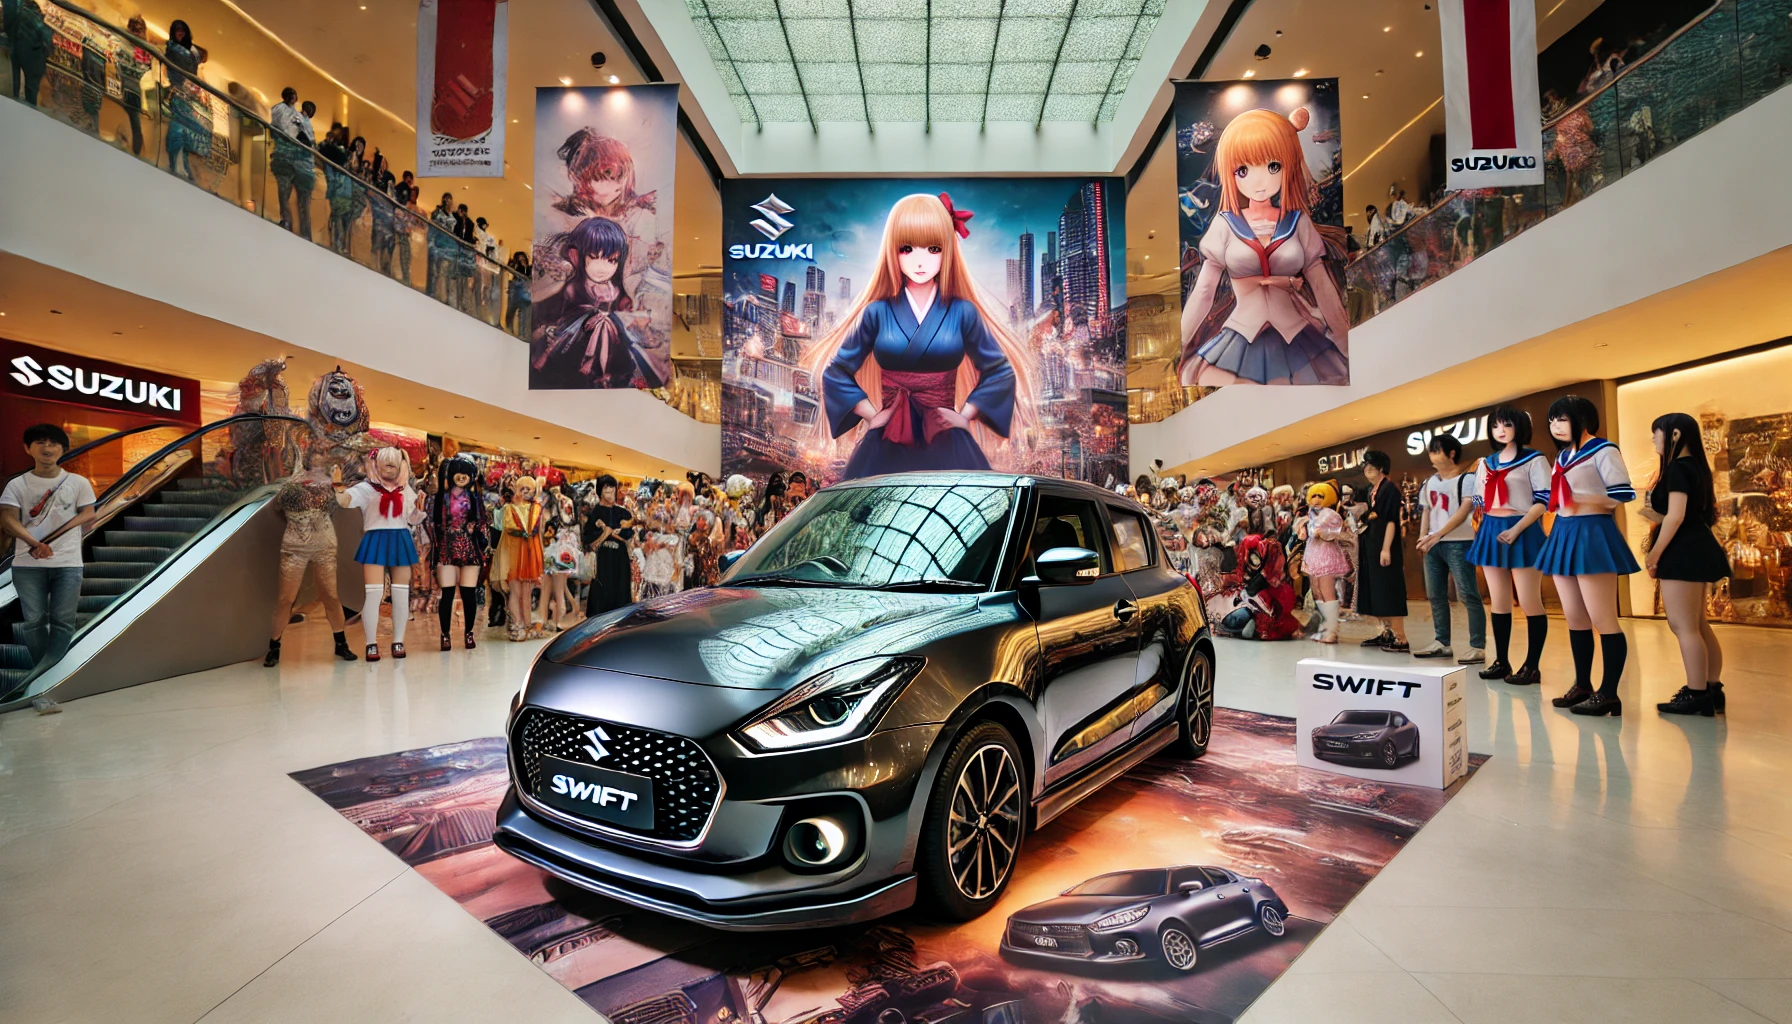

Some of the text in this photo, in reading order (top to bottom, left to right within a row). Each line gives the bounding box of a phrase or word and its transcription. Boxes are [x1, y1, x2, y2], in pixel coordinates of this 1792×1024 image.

[729, 243, 813, 260] SUZUKI
[47, 365, 181, 411] SUZUKI
[1312, 673, 1422, 698] SWIFT
[550, 774, 638, 811] SWIFT
